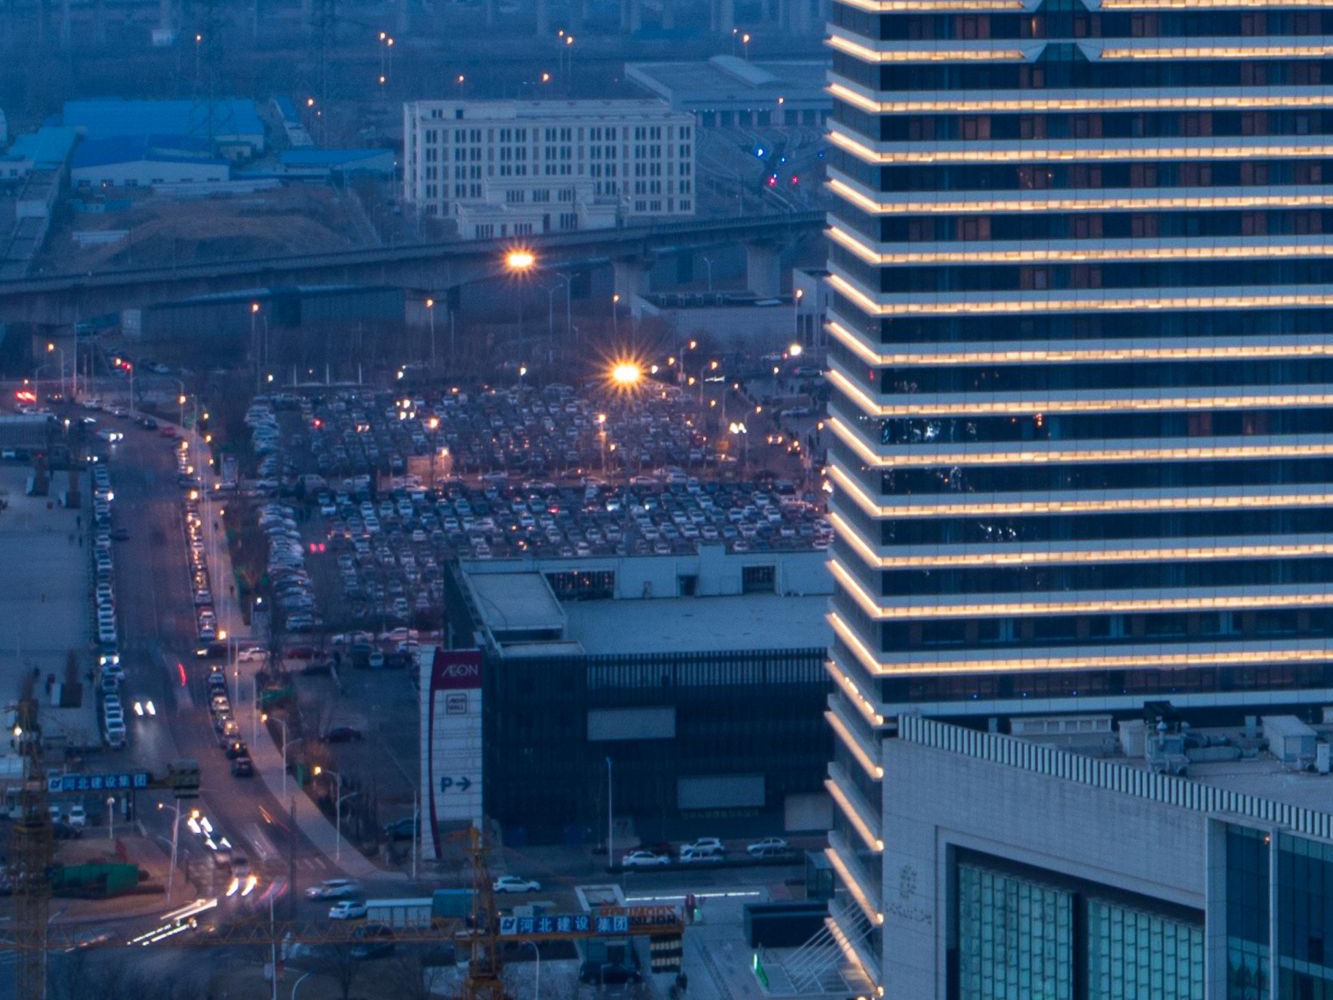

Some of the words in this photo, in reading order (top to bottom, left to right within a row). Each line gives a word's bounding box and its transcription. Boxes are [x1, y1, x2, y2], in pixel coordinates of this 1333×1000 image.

[441, 777, 452, 793] P
[520, 915, 628, 933] 河北建设集团
